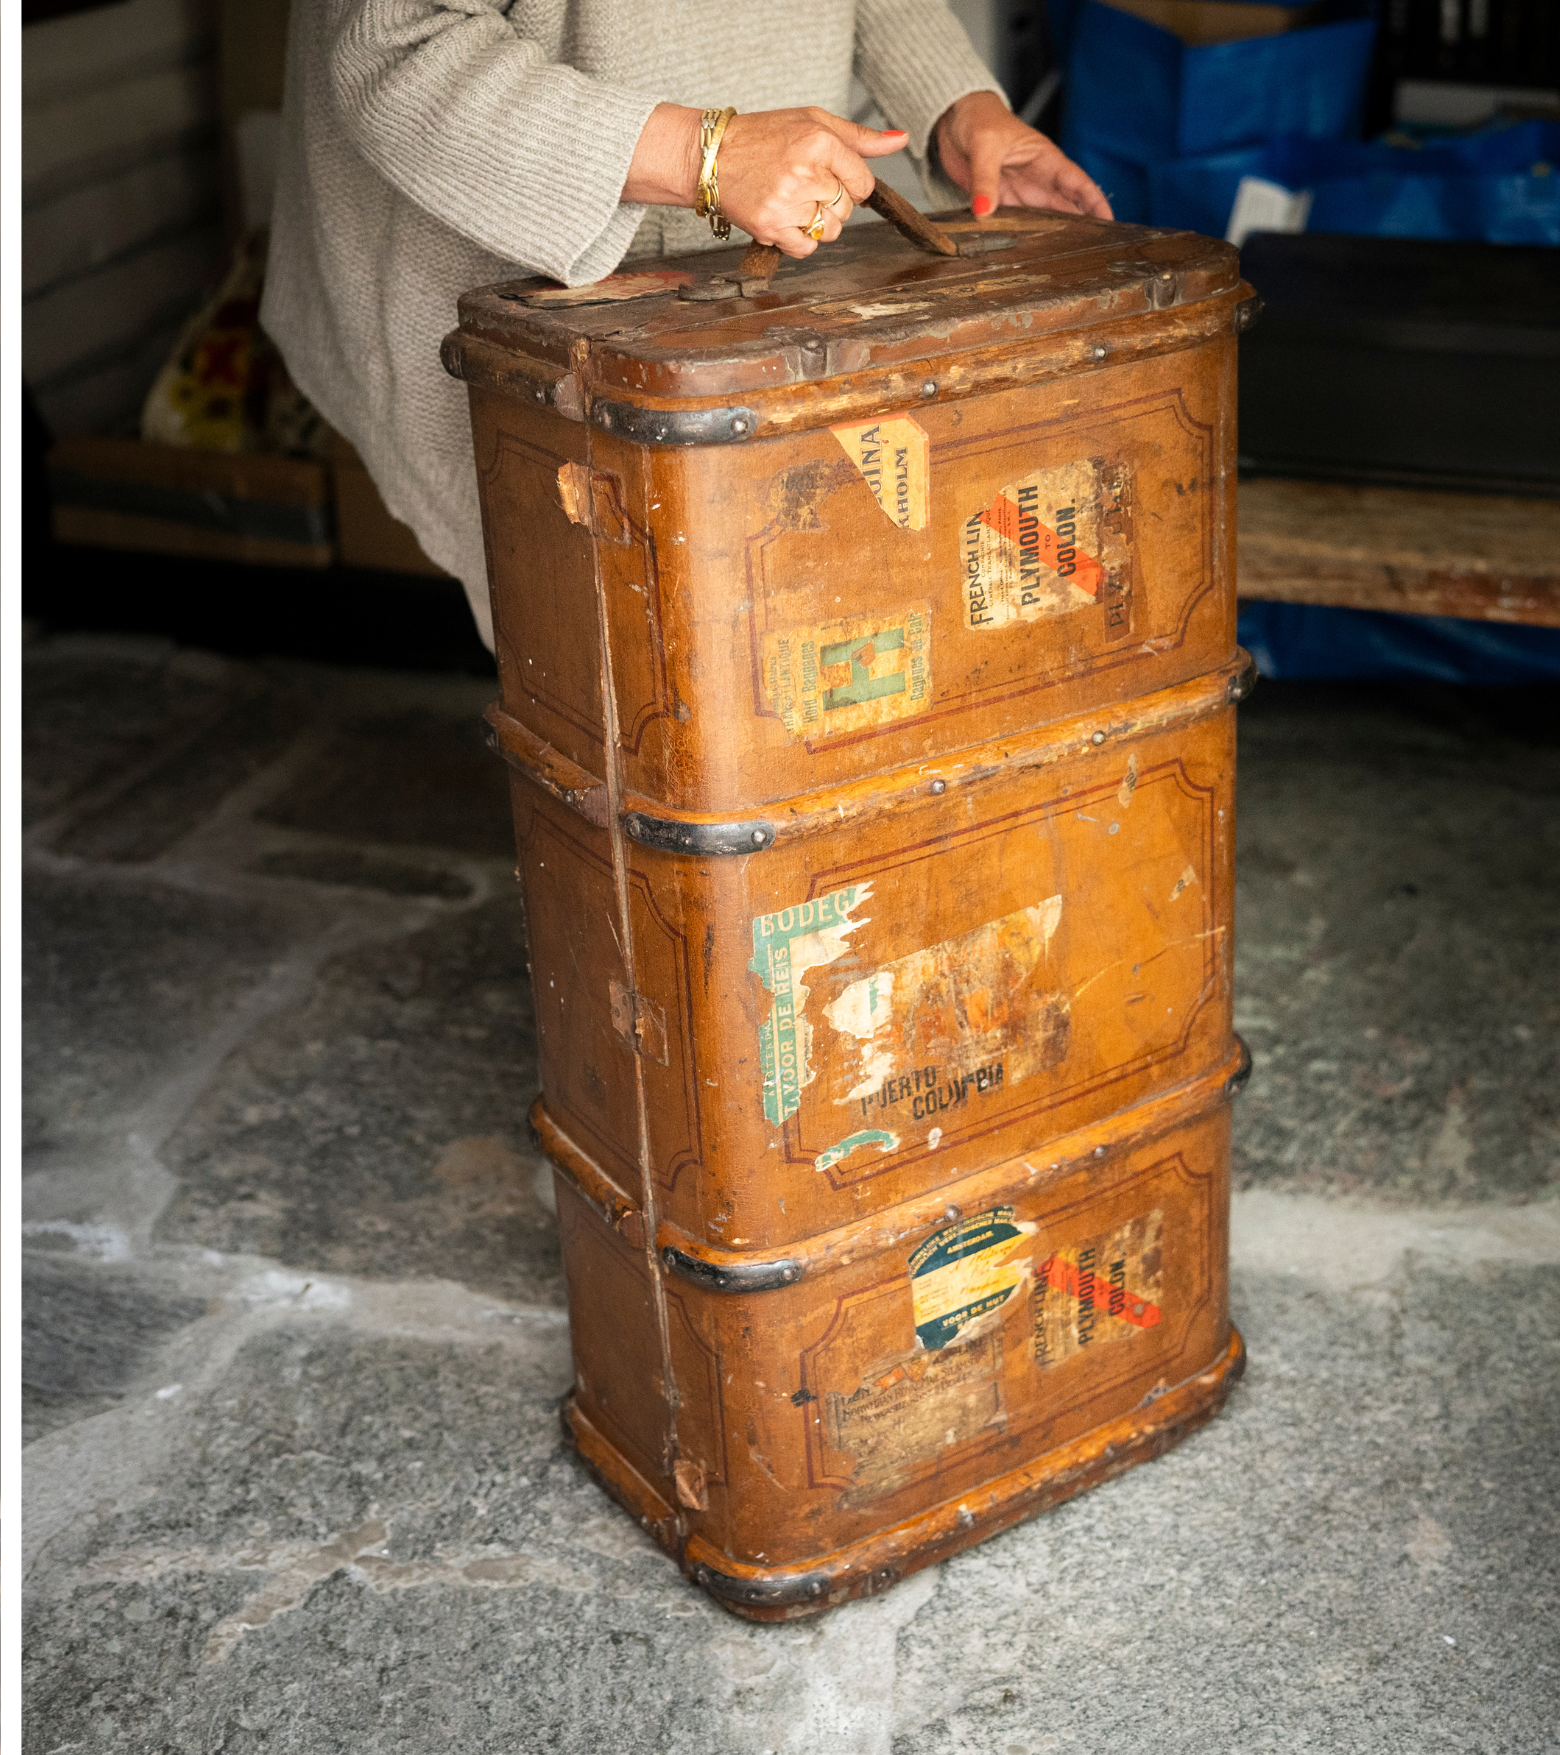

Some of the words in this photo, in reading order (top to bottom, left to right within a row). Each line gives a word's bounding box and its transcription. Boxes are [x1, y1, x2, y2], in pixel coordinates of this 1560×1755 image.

[859, 425, 883, 508] GINA
[895, 447, 909, 527] KHOLM
[1019, 486, 1040, 606] PLYMOUTH
[1045, 535, 1051, 549] TO
[1056, 499, 1076, 577] COLON.
[968, 549, 994, 625] FRENCH
[802, 641, 818, 692] Baggages
[911, 656, 924, 701] Bagages
[803, 699, 818, 723] Hold
[760, 888, 854, 936] BODEG
[775, 946, 790, 994] REIS
[779, 1003, 792, 1029] DE
[780, 1039, 796, 1095] VOOR
[942, 1311, 969, 1327] VOOR
[970, 1304, 984, 1314] DE
[985, 1294, 1006, 1307] HUT
[1078, 1248, 1095, 1345] PLYMOUTH
